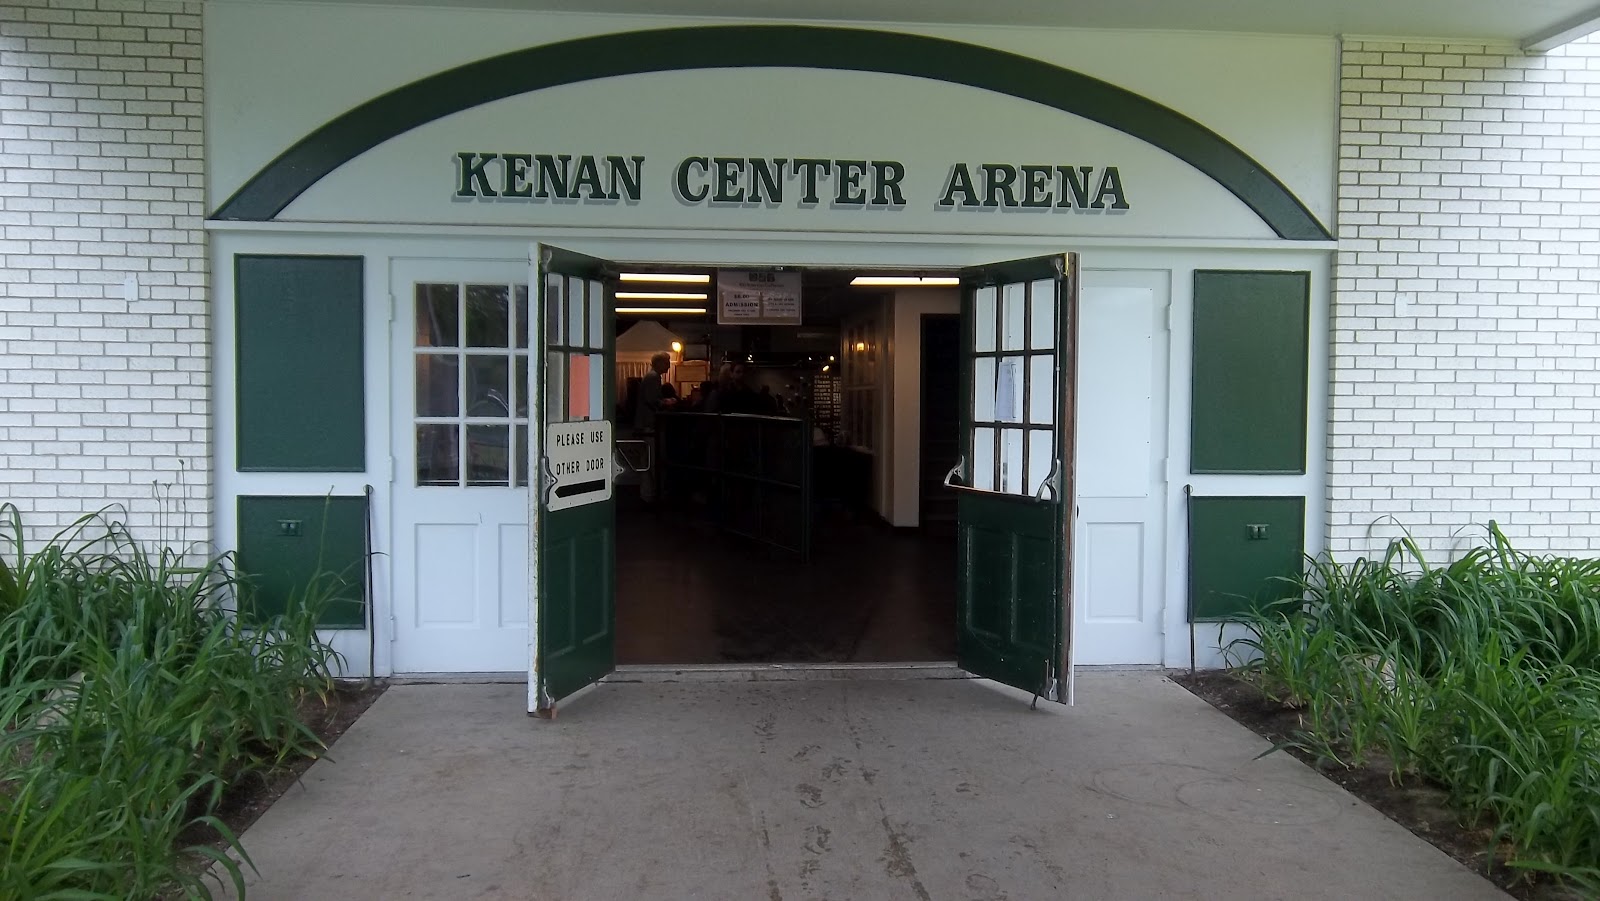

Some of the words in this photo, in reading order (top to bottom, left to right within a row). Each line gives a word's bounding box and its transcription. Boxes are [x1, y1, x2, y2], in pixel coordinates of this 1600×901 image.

[454, 151, 646, 202] KENAN
[673, 156, 907, 208] CENTER
[935, 162, 1130, 212] ARENA
[557, 432, 585, 447] PLEASE
[591, 431, 604, 443] USE
[556, 460, 580, 475] OTHER
[586, 458, 604, 472] DOOR
